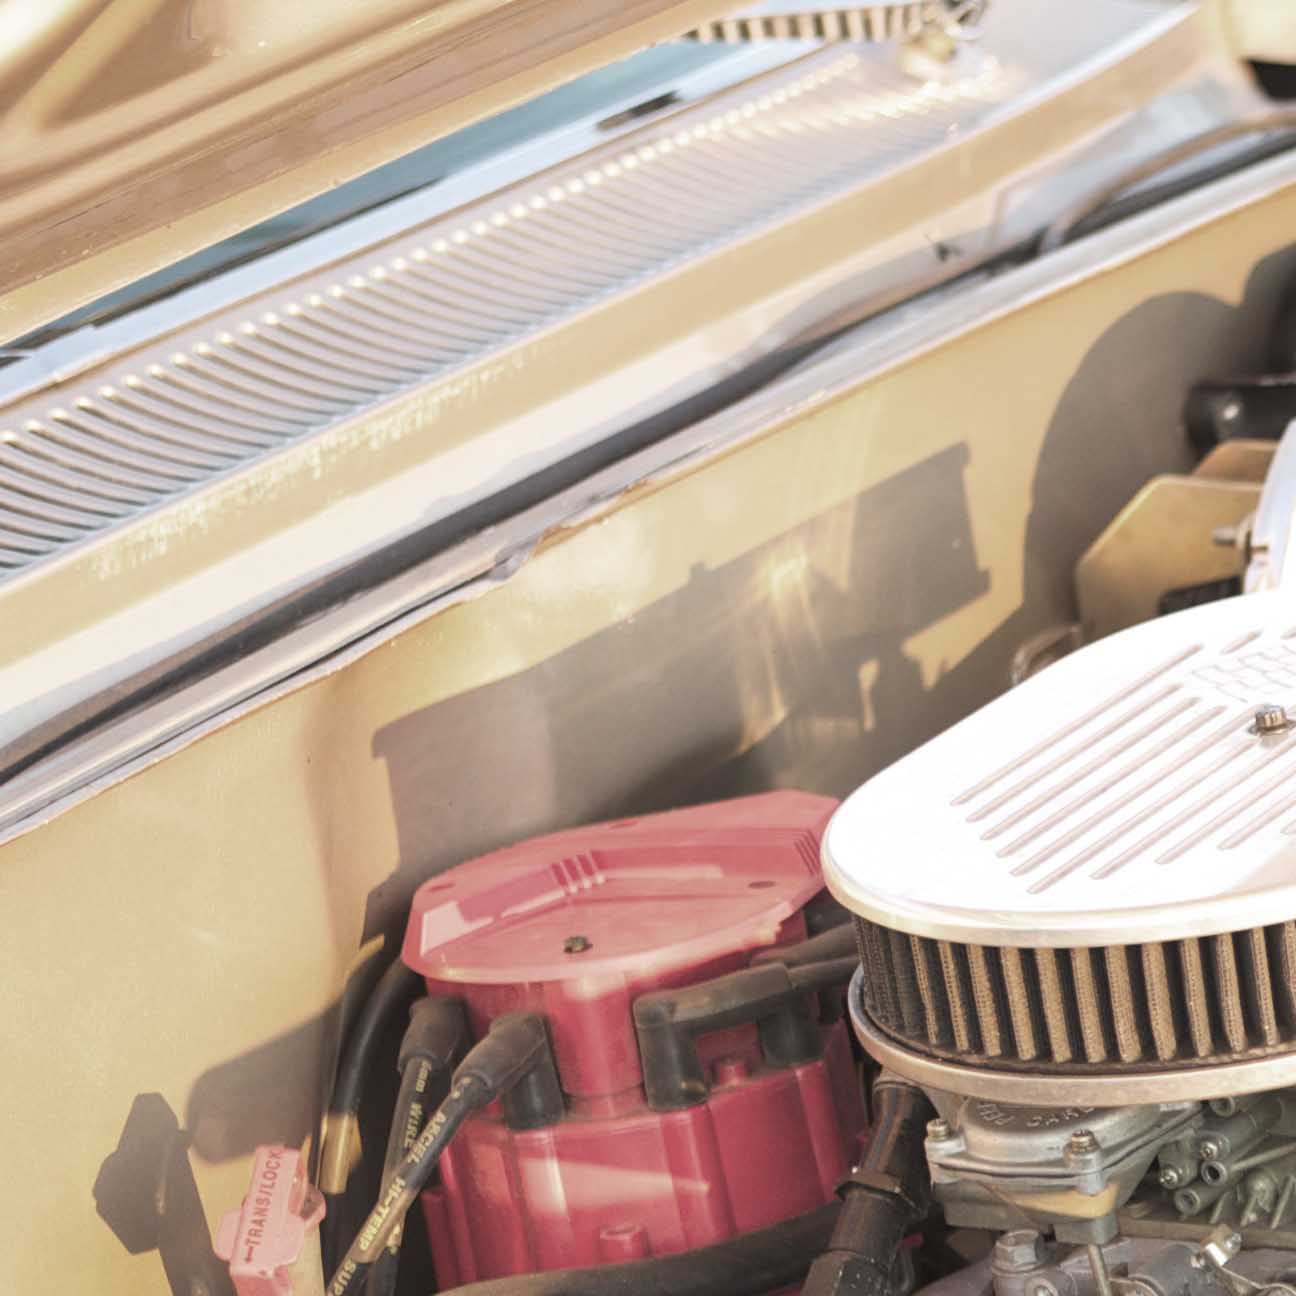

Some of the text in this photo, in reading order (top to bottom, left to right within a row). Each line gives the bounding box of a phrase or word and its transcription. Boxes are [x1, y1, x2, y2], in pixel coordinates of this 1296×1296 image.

[407, 1111, 447, 1164] ACCEL
[246, 1147, 283, 1247] TRANS/LOCK
[358, 1176, 406, 1251] HI-TEMP
